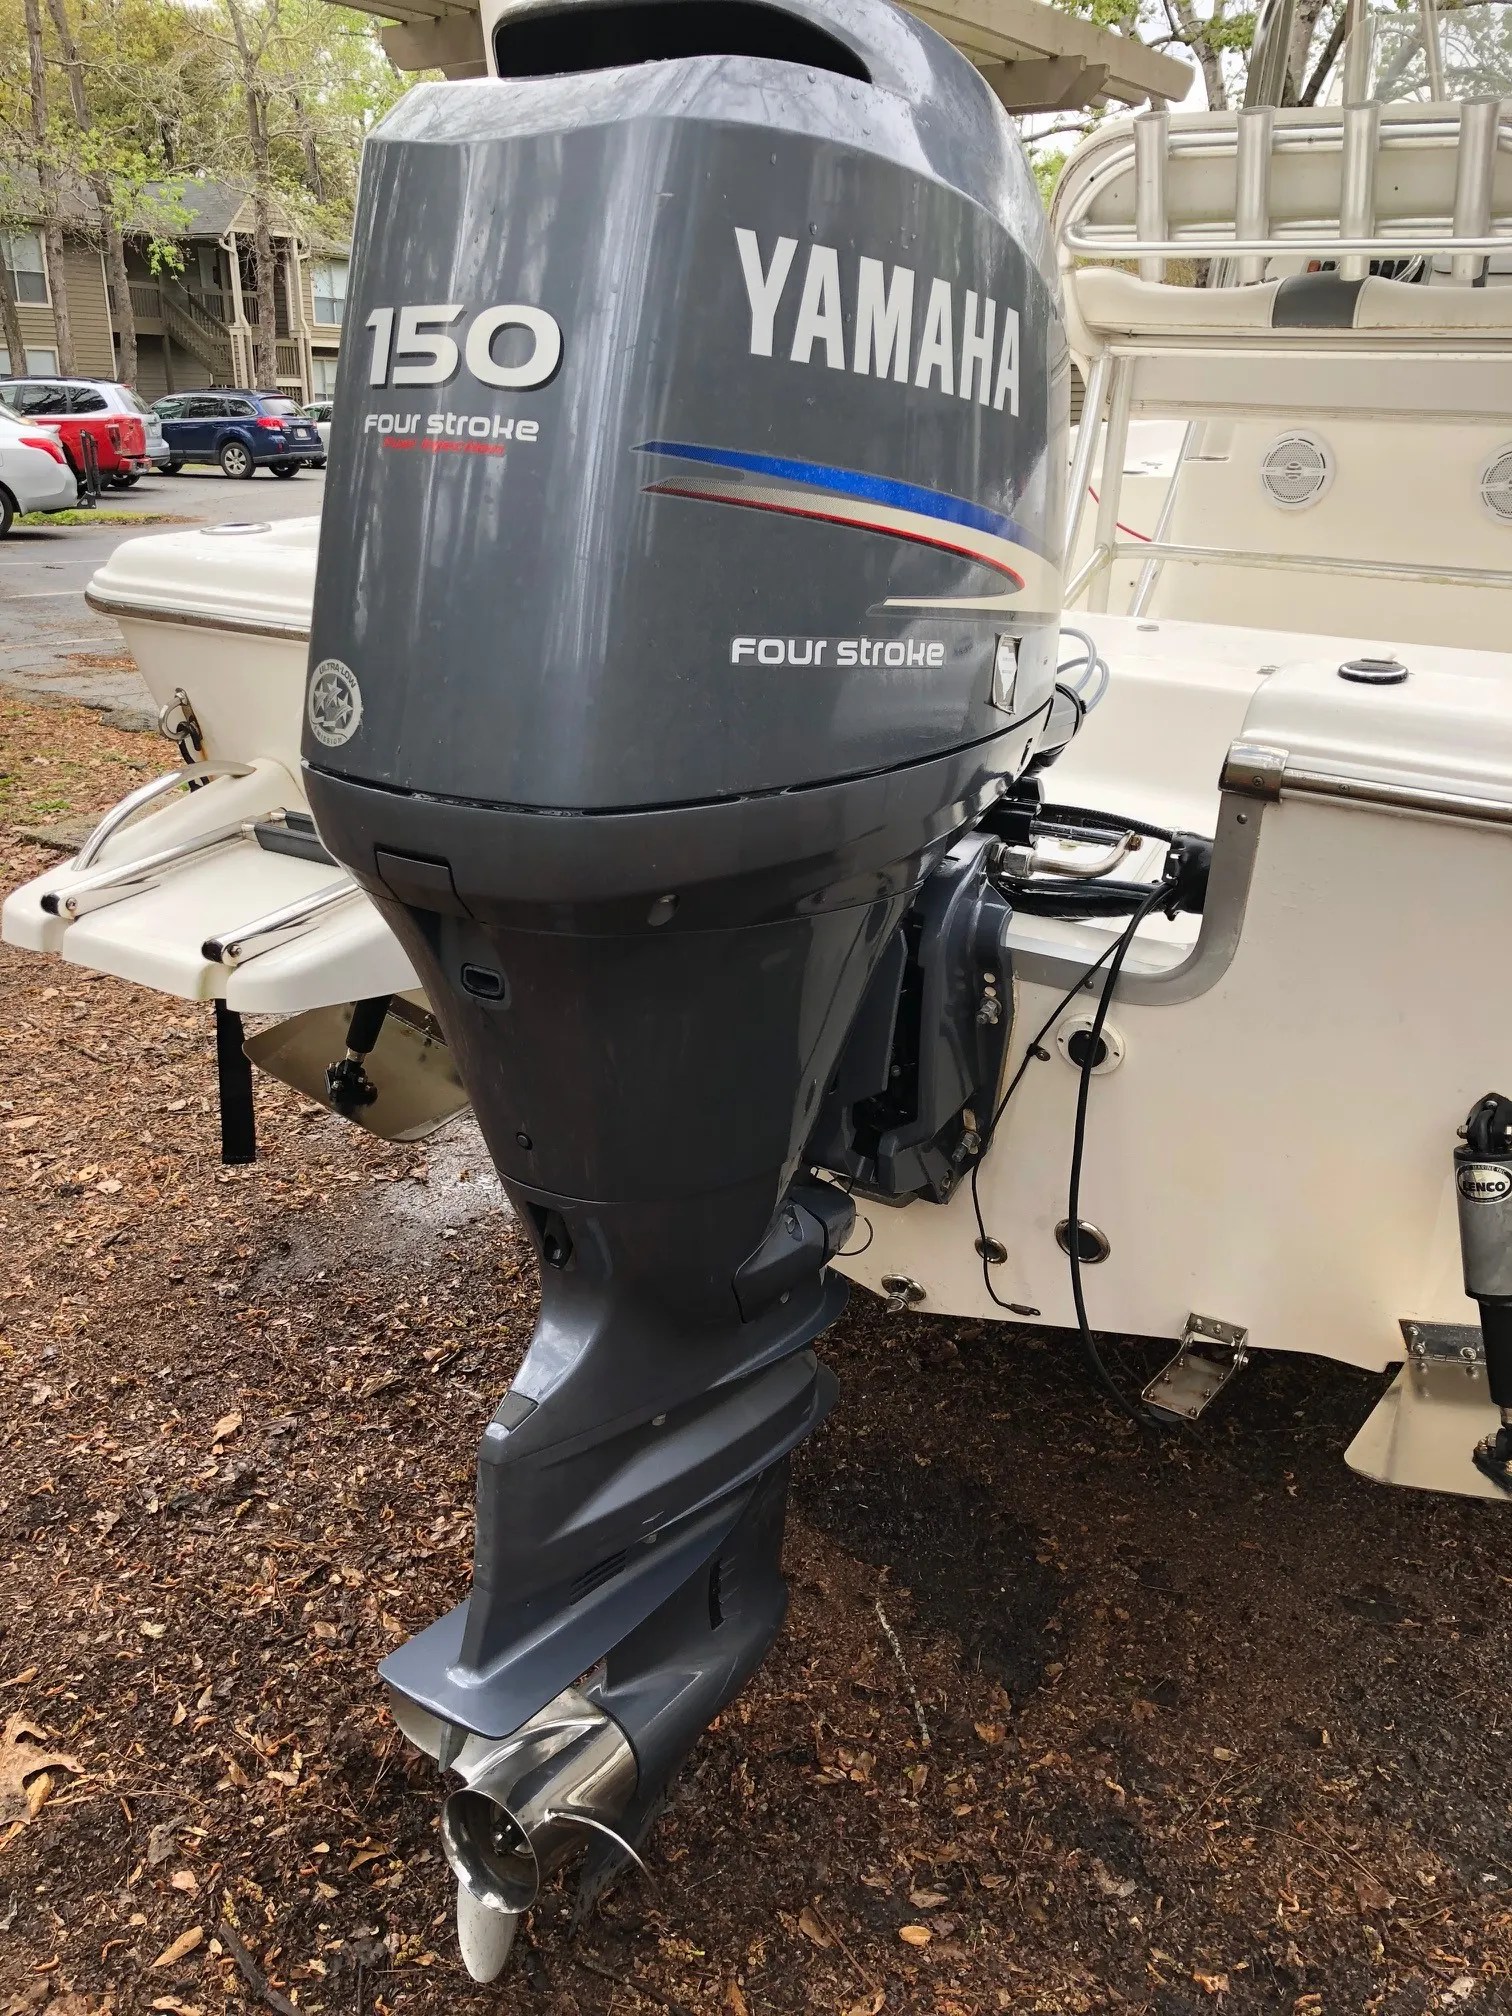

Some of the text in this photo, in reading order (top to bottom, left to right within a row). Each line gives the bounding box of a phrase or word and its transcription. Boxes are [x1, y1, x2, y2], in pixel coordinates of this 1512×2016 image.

[365, 304, 564, 392] 150
[734, 226, 1020, 418] YAMAHA
[1462, 1180, 1506, 1192] LENCO
